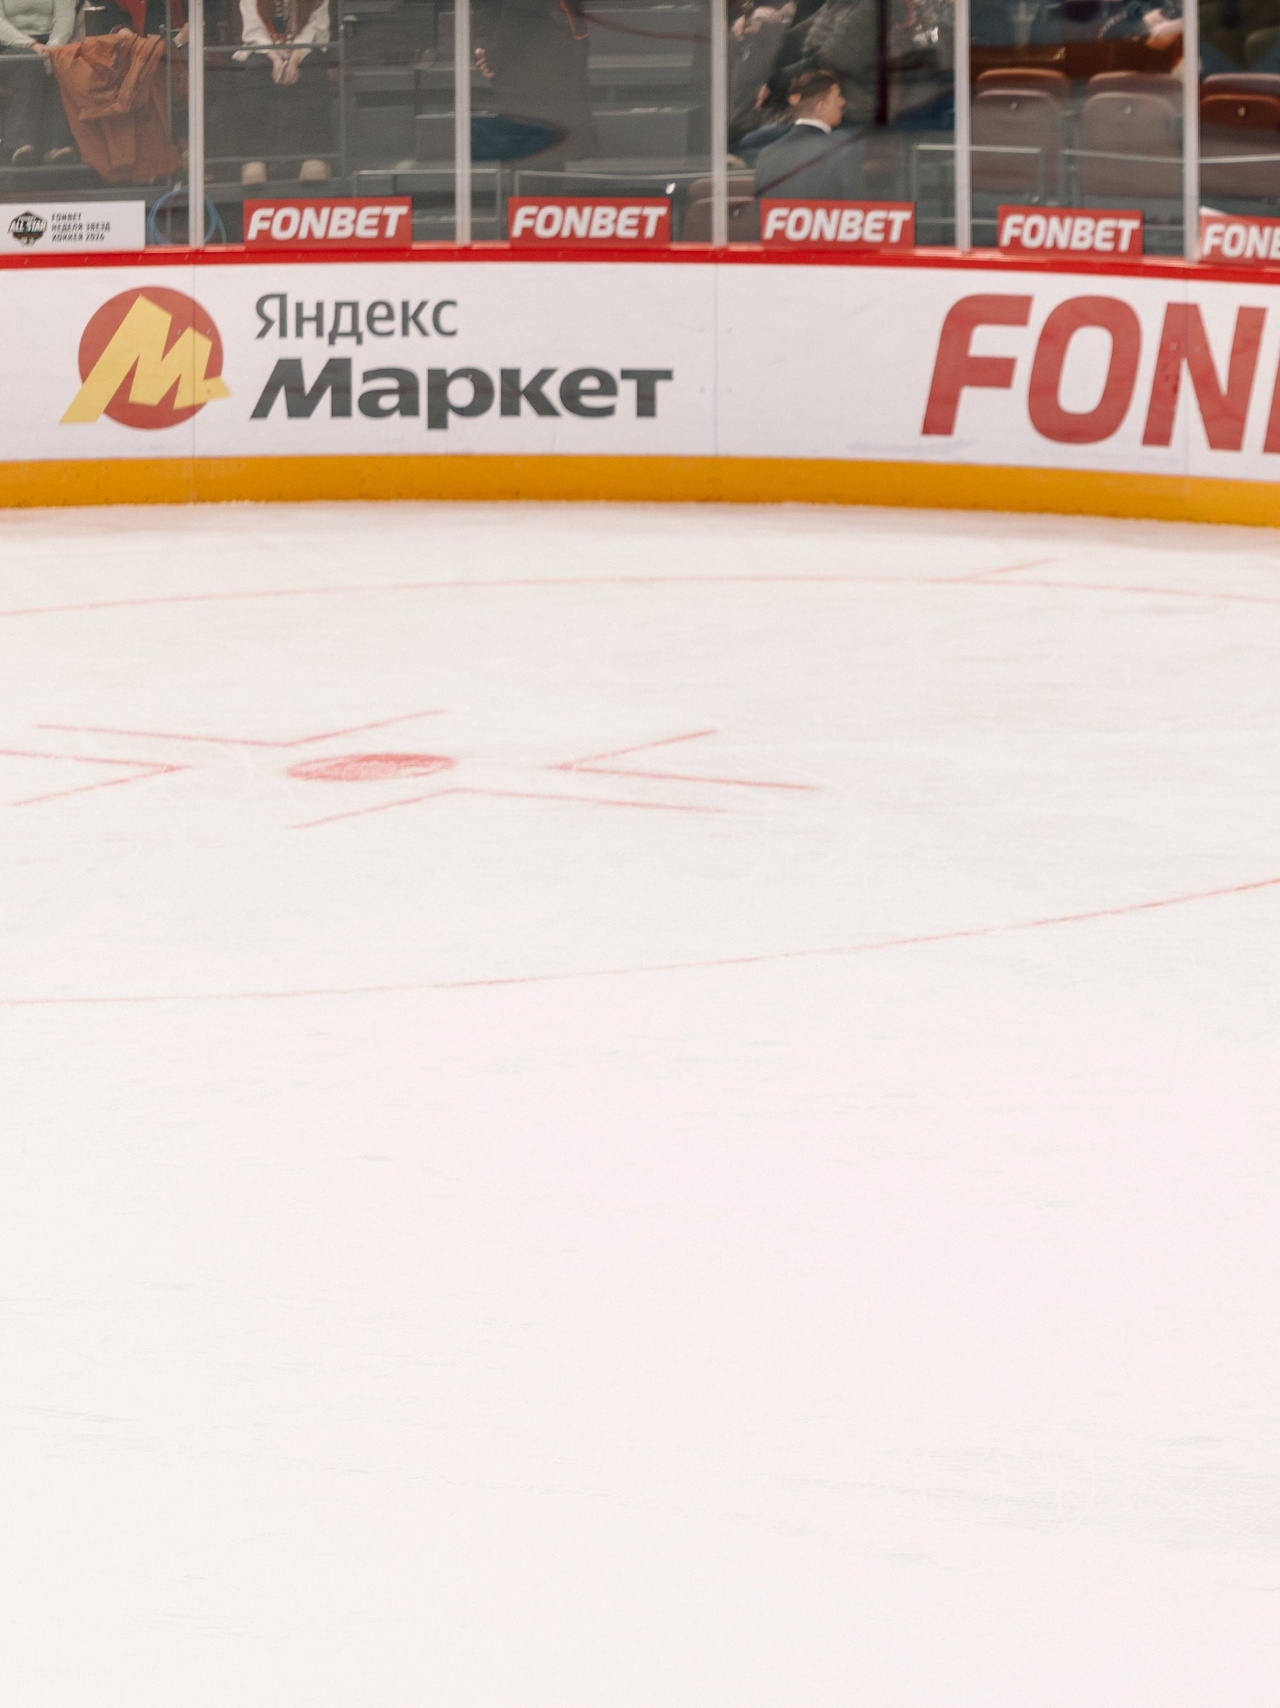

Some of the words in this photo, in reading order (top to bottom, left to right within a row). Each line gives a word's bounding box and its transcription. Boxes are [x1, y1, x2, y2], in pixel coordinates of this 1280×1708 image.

[247, 206, 409, 241] FONBET
[512, 206, 667, 238] FONBET
[764, 208, 911, 242] FONBET
[1001, 214, 1139, 252] FONBET
[255, 293, 457, 346] Яндекс
[250, 357, 673, 430] Маркет
